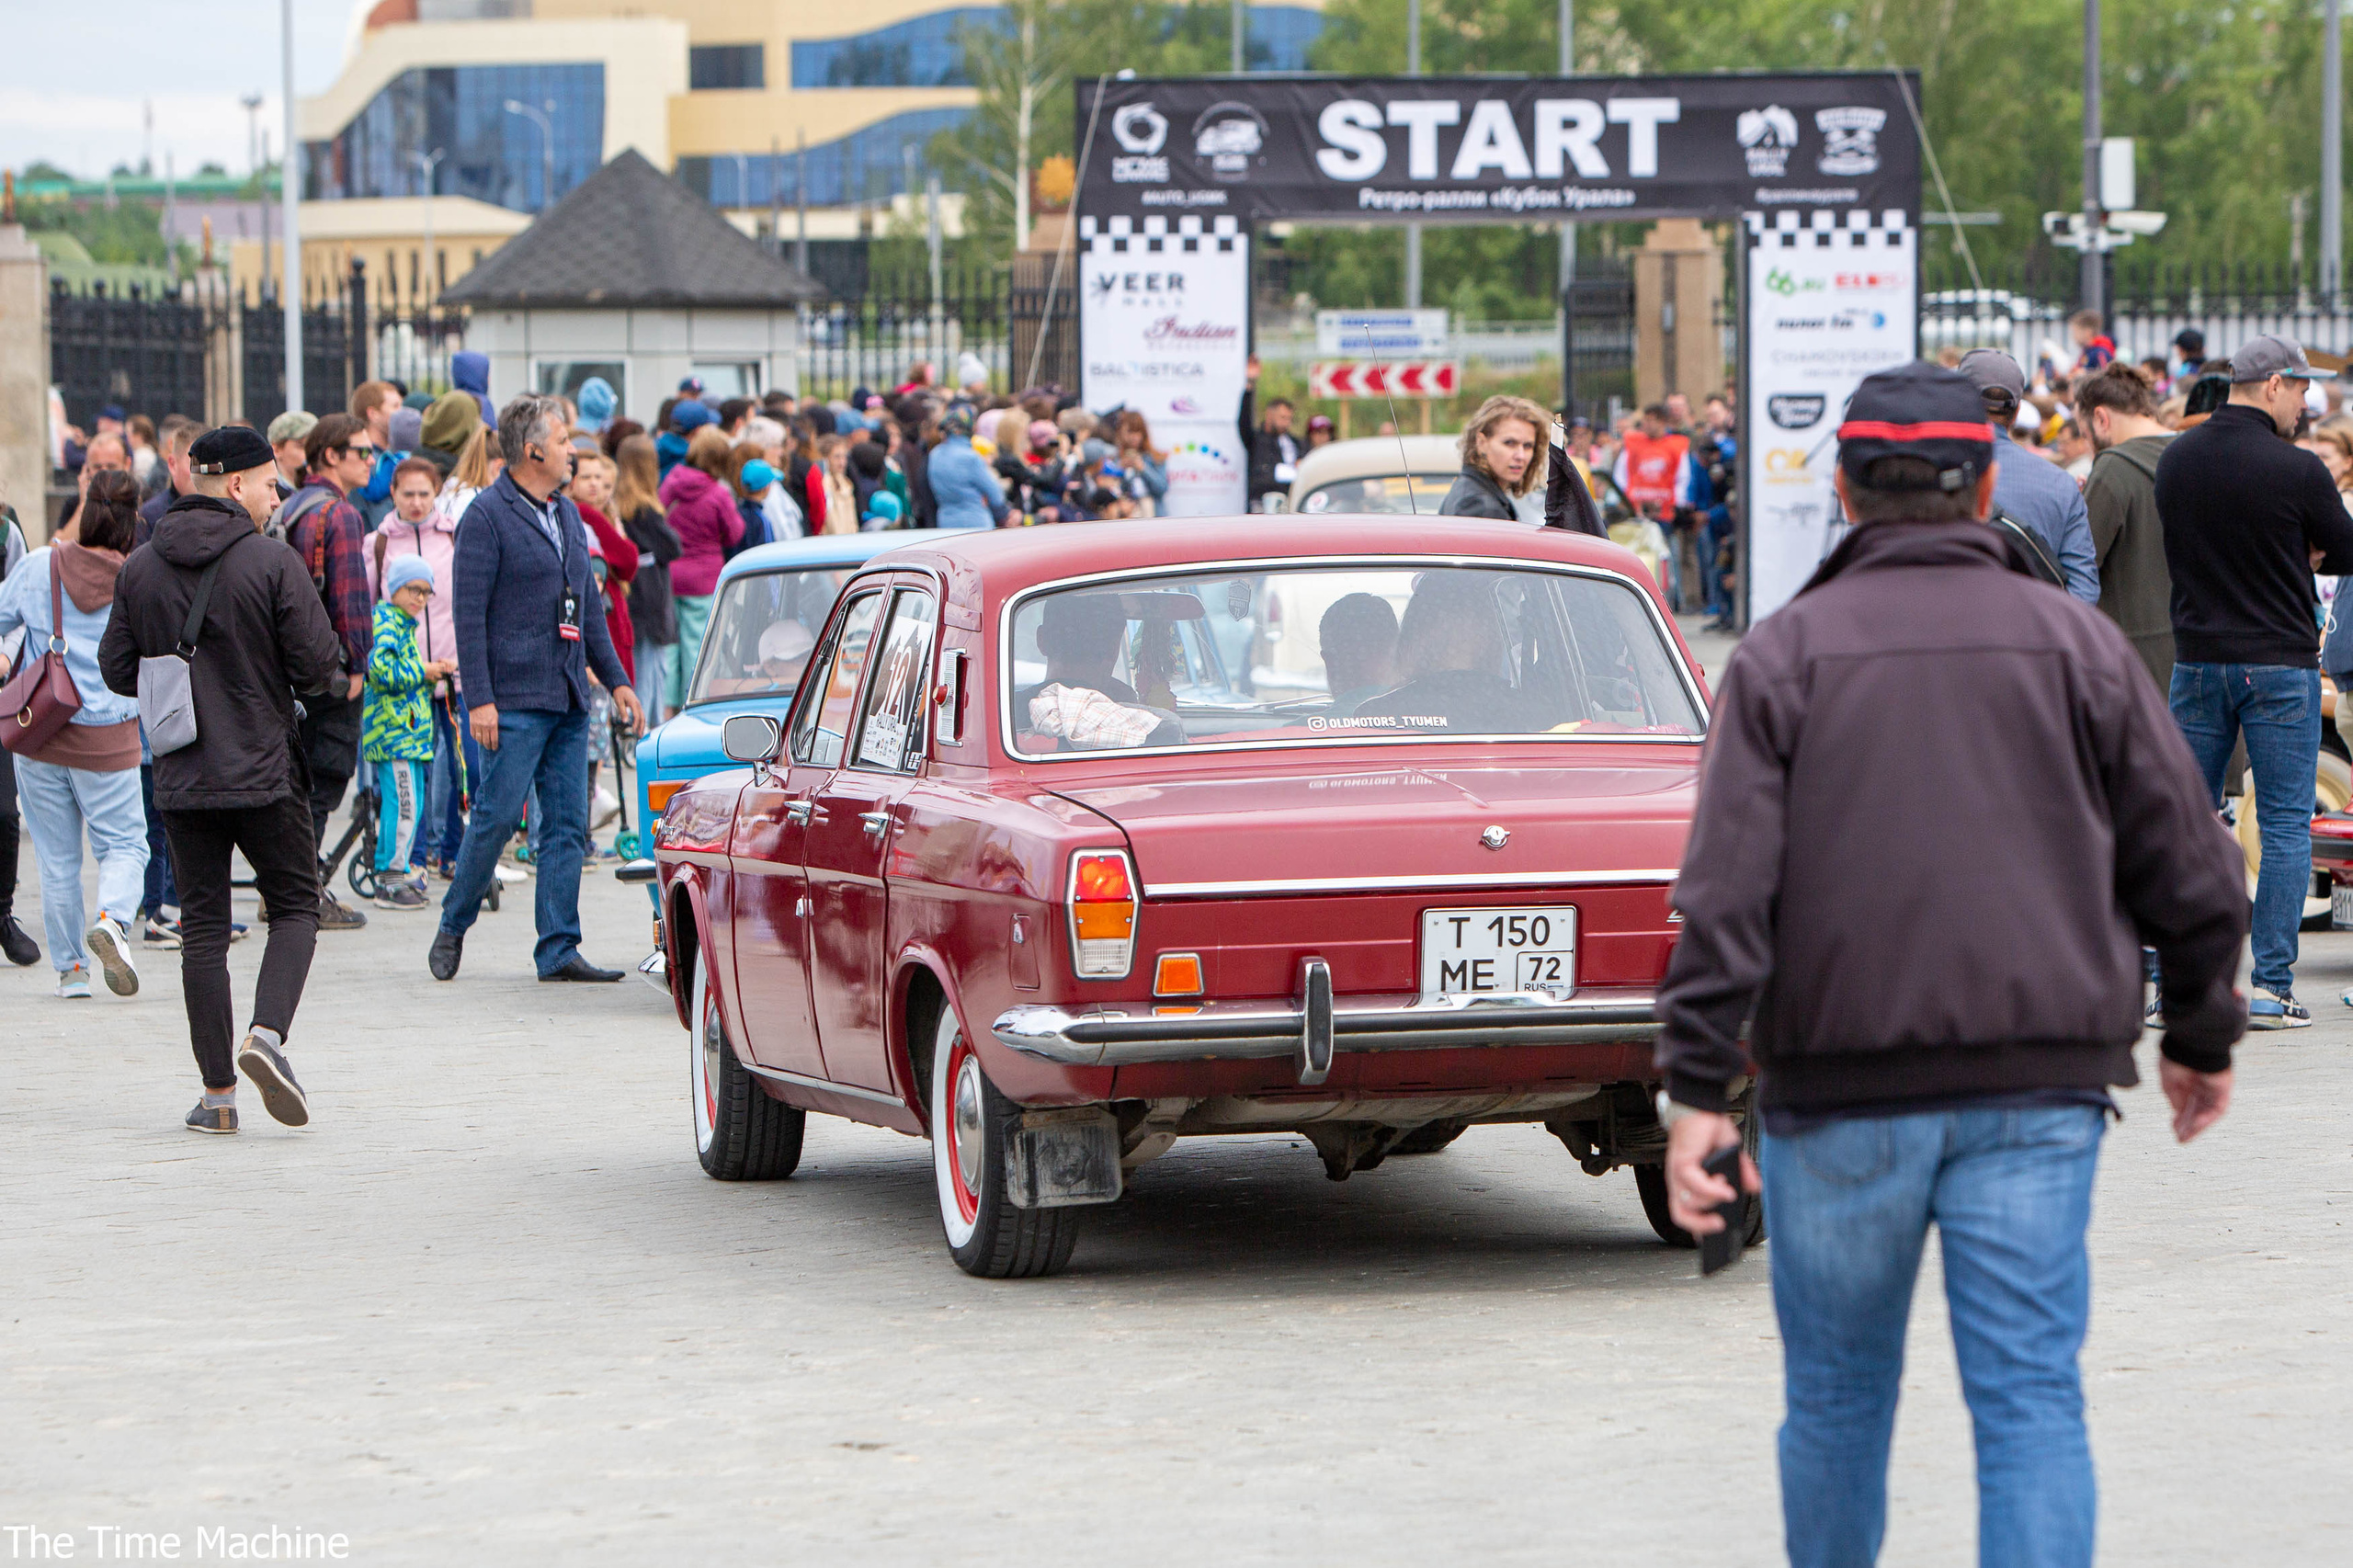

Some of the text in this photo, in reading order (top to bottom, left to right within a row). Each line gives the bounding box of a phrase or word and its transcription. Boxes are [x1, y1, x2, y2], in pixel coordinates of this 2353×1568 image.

[1316, 98, 1680, 181] START
[1098, 272, 1186, 291] VEER
[1329, 716, 1448, 729] OLDMOTORS_TYUMEN
[398, 770, 412, 821] RUSSIA
[1448, 915, 1550, 949] T 150
[1441, 959, 1495, 991] ME
[1529, 956, 1561, 981] 72
